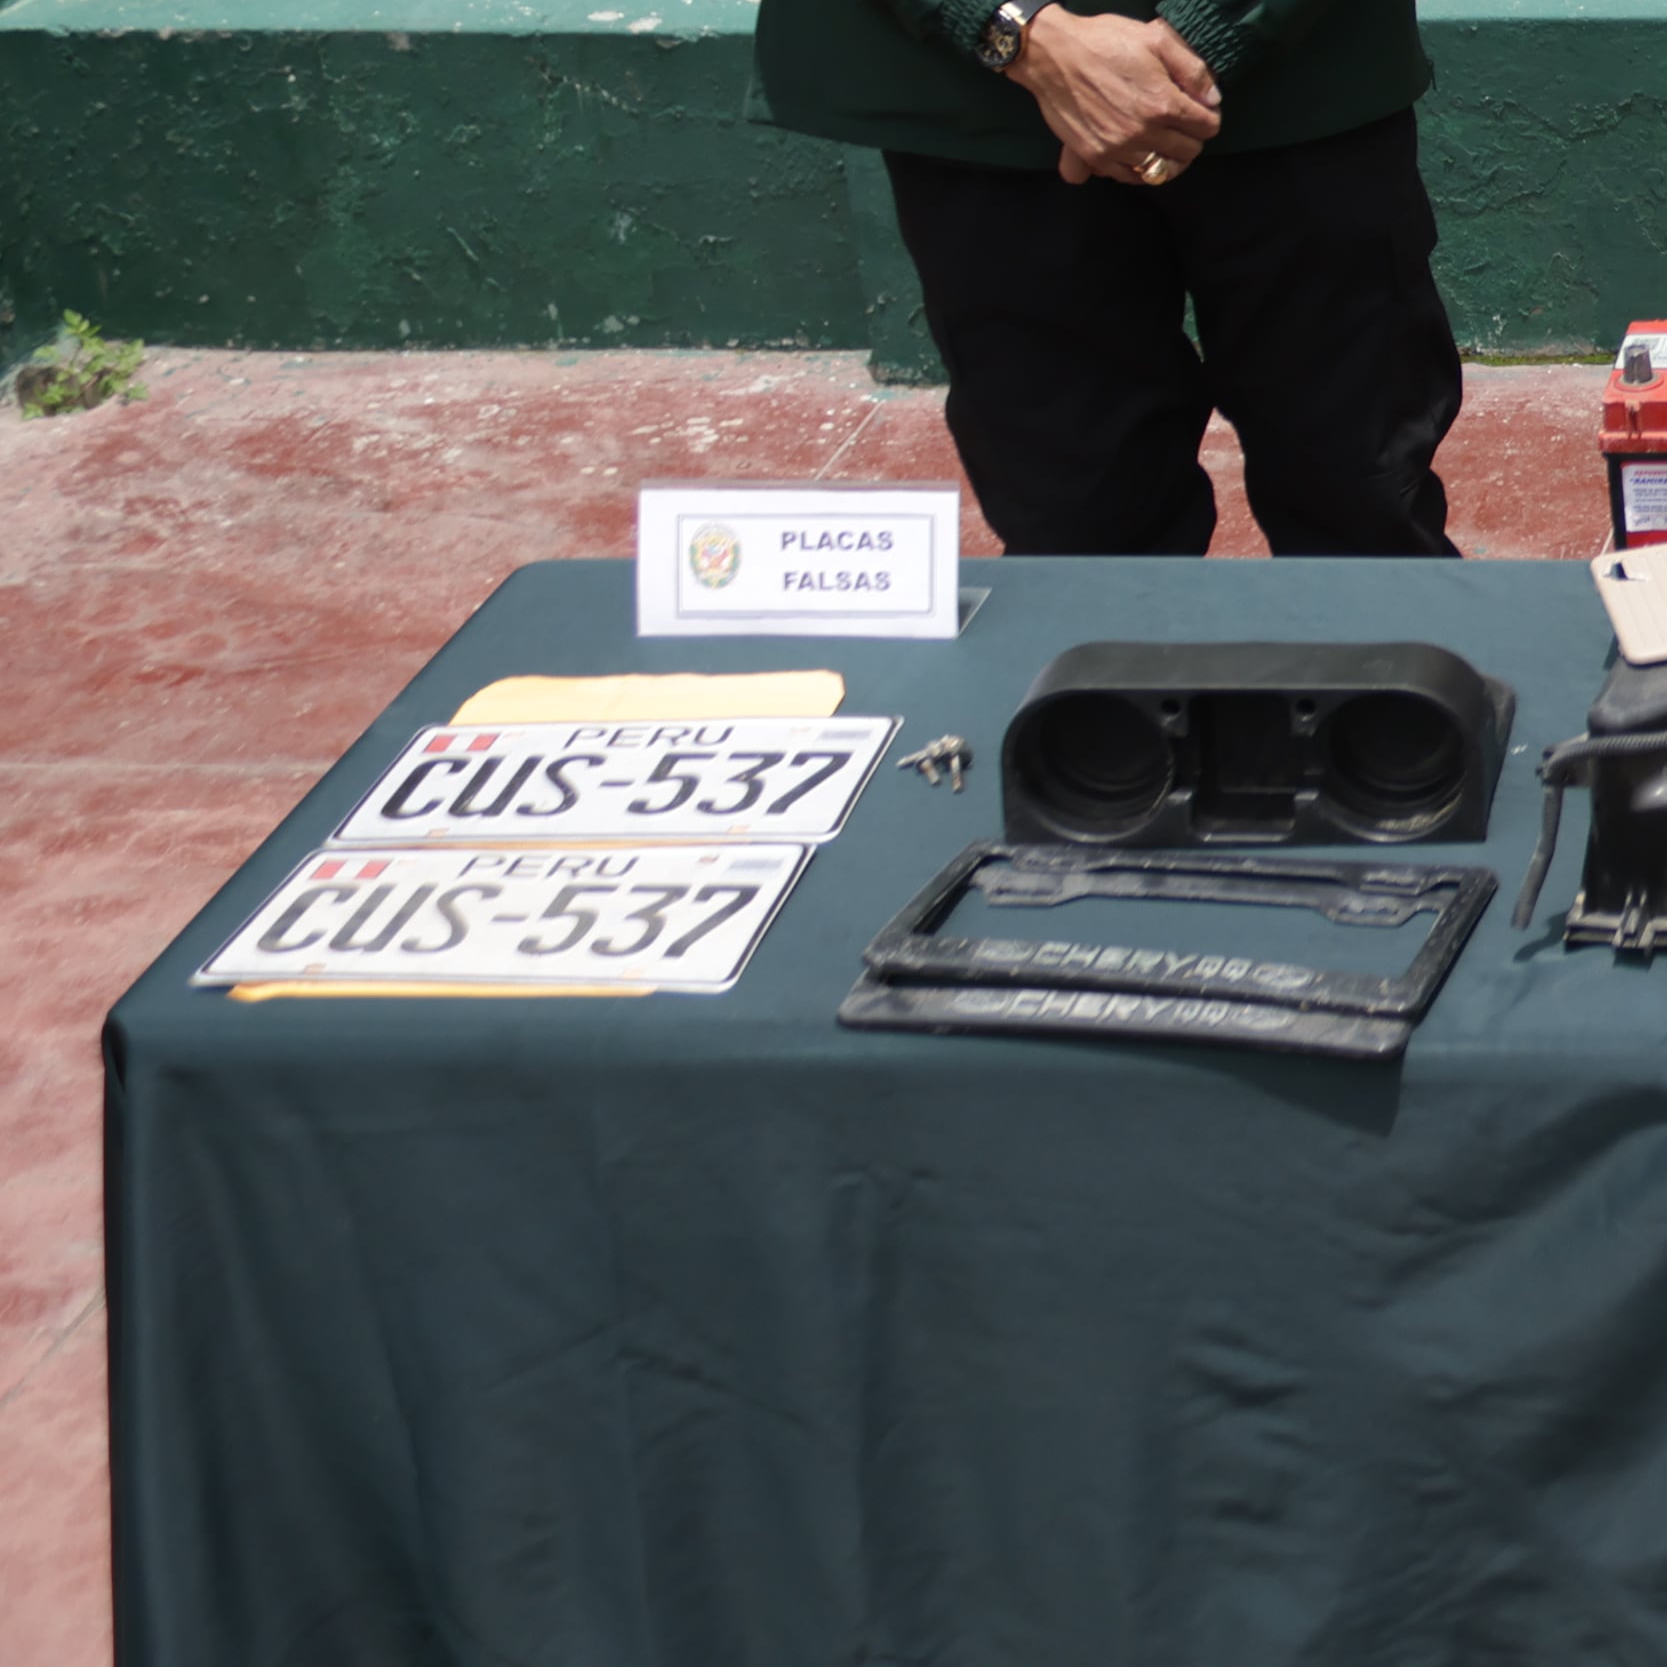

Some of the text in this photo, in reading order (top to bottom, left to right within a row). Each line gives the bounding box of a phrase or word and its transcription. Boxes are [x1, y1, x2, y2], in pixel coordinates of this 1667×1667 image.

[781, 530, 894, 551] PLACAS
[783, 571, 892, 592] FALSAS
[563, 725, 735, 750] PERU
[381, 751, 853, 820] CUS-537
[458, 853, 640, 879] PERU
[255, 883, 760, 959] CUS-537
